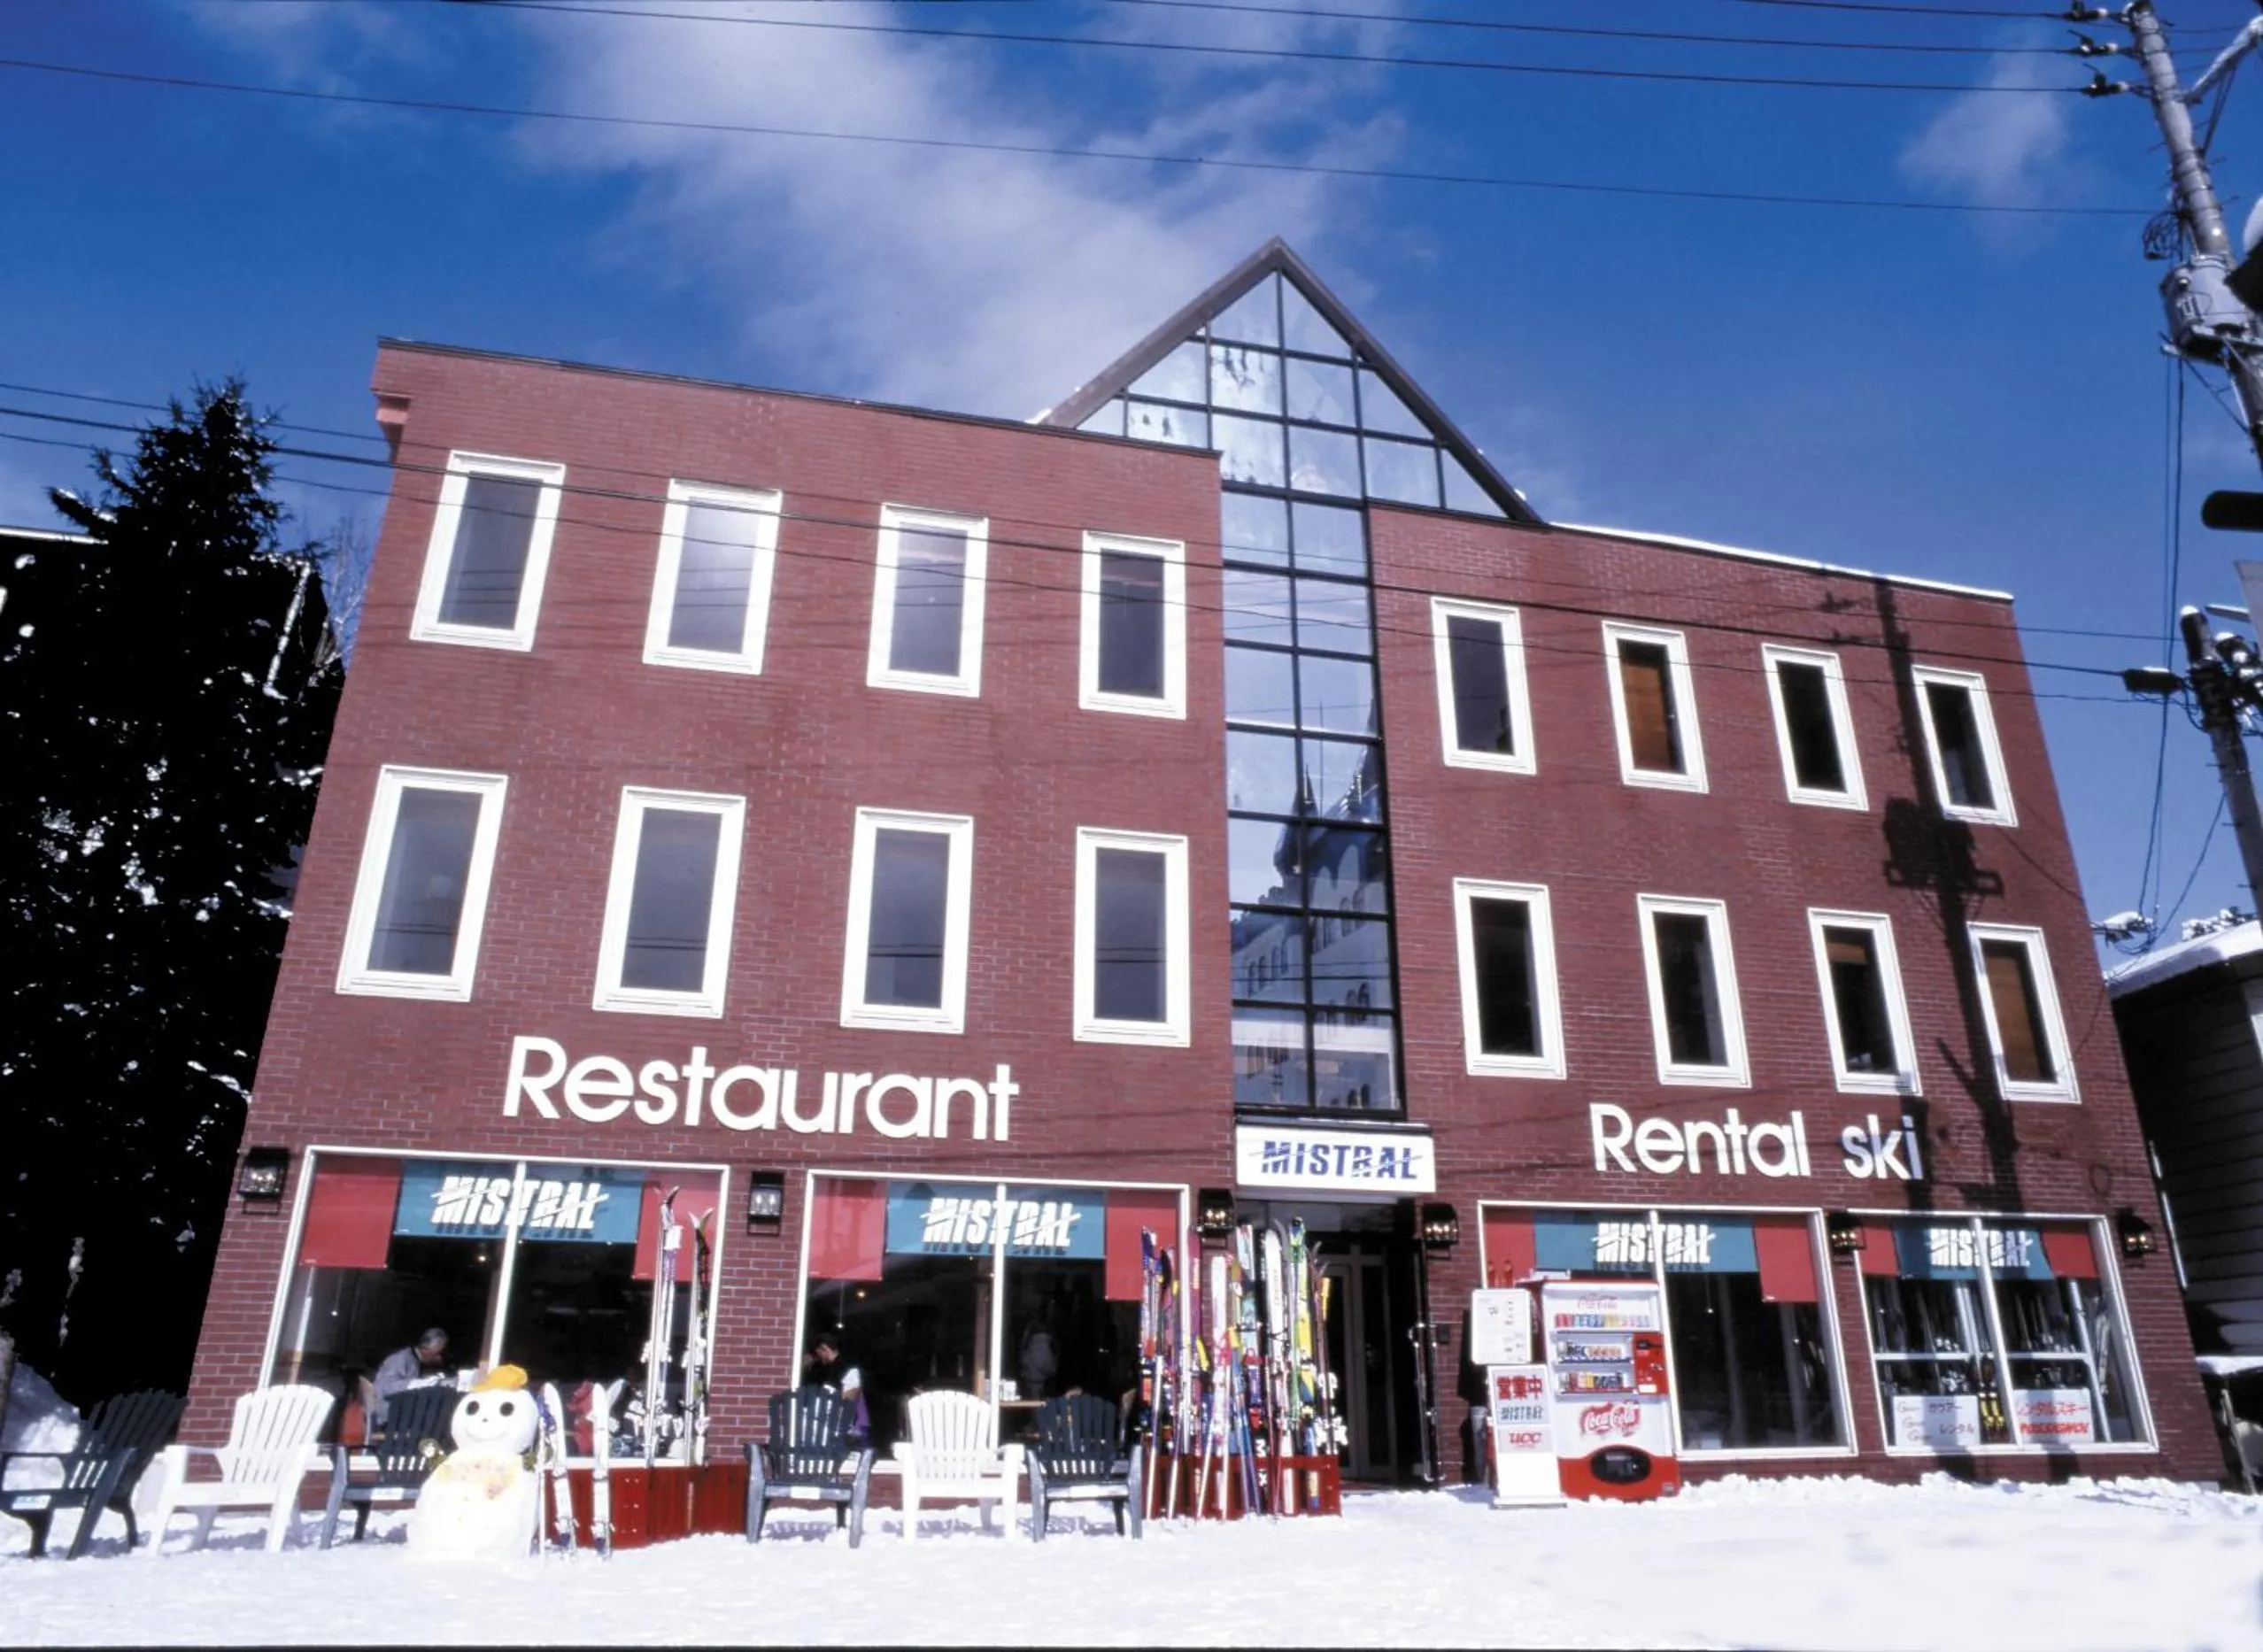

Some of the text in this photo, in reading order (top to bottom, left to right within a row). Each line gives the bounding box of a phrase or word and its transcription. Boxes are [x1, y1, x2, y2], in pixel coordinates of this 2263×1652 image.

[503, 1035, 1019, 1141] Restaurant
[1259, 1140, 1419, 1179] MISTRAL
[1589, 1102, 1923, 1179] Rental ski
[430, 1176, 610, 1229] MISTRAL
[919, 1198, 1082, 1247] MISTRAL
[1497, 1374, 1543, 1401] 営業中
[1509, 1432, 1543, 1445] UCC
